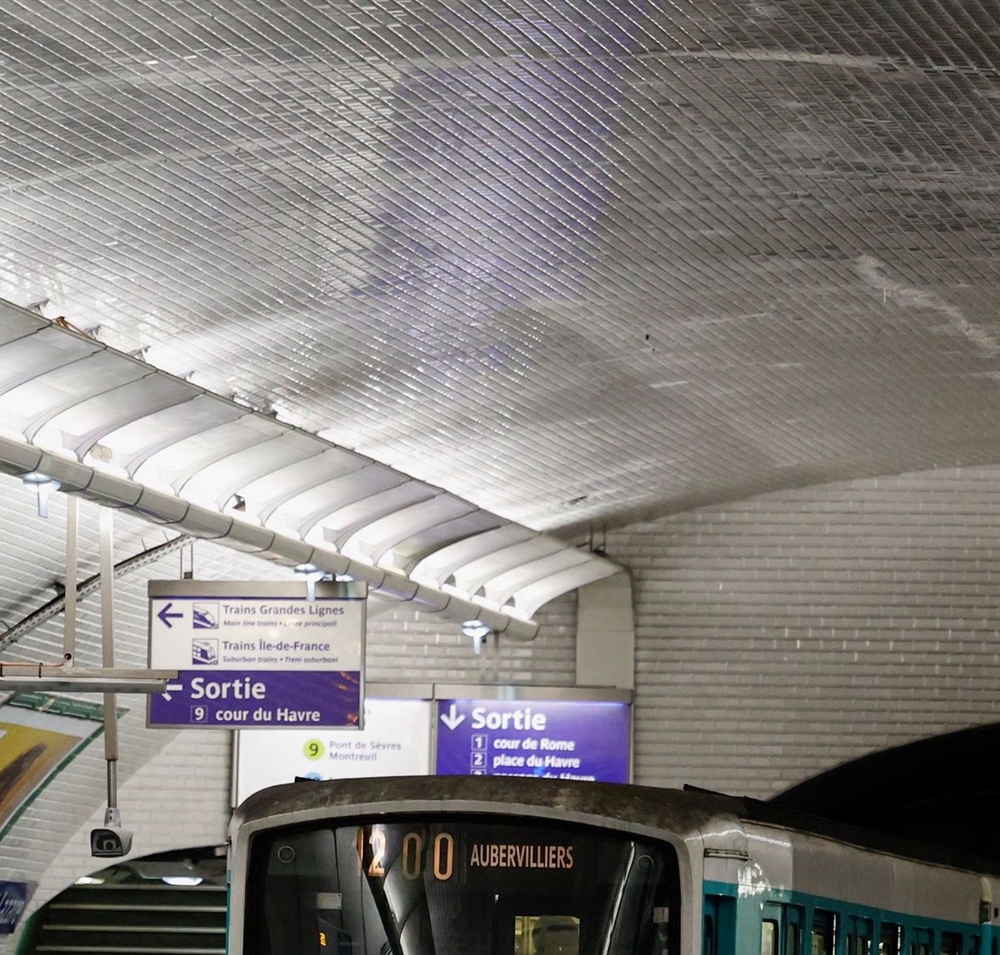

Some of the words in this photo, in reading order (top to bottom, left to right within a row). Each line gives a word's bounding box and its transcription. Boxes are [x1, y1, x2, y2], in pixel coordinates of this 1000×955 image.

[222, 605, 256, 615] Trains
[260, 605, 305, 615] Grandes
[309, 605, 344, 617] Lignes
[222, 641, 255, 651] Trains
[259, 638, 330, 651] Île-de-France
[191, 677, 266, 699] Sortie
[216, 709, 248, 721] cour
[253, 707, 271, 721] du
[277, 708, 320, 722] Havre
[471, 707, 546, 730] Sortie
[309, 743, 319, 756] 9
[329, 741, 352, 750] Pont
[355, 741, 367, 750] de
[370, 741, 402, 750] Sèvres
[493, 738, 520, 750] cour
[522, 738, 538, 750] de
[540, 738, 575, 751] Rome
[329, 752, 377, 761] Montreuil
[493, 754, 525, 768] place
[526, 754, 543, 767] du
[544, 755, 580, 768] Havre
[470, 844, 574, 869] AUBERVILLIERS
